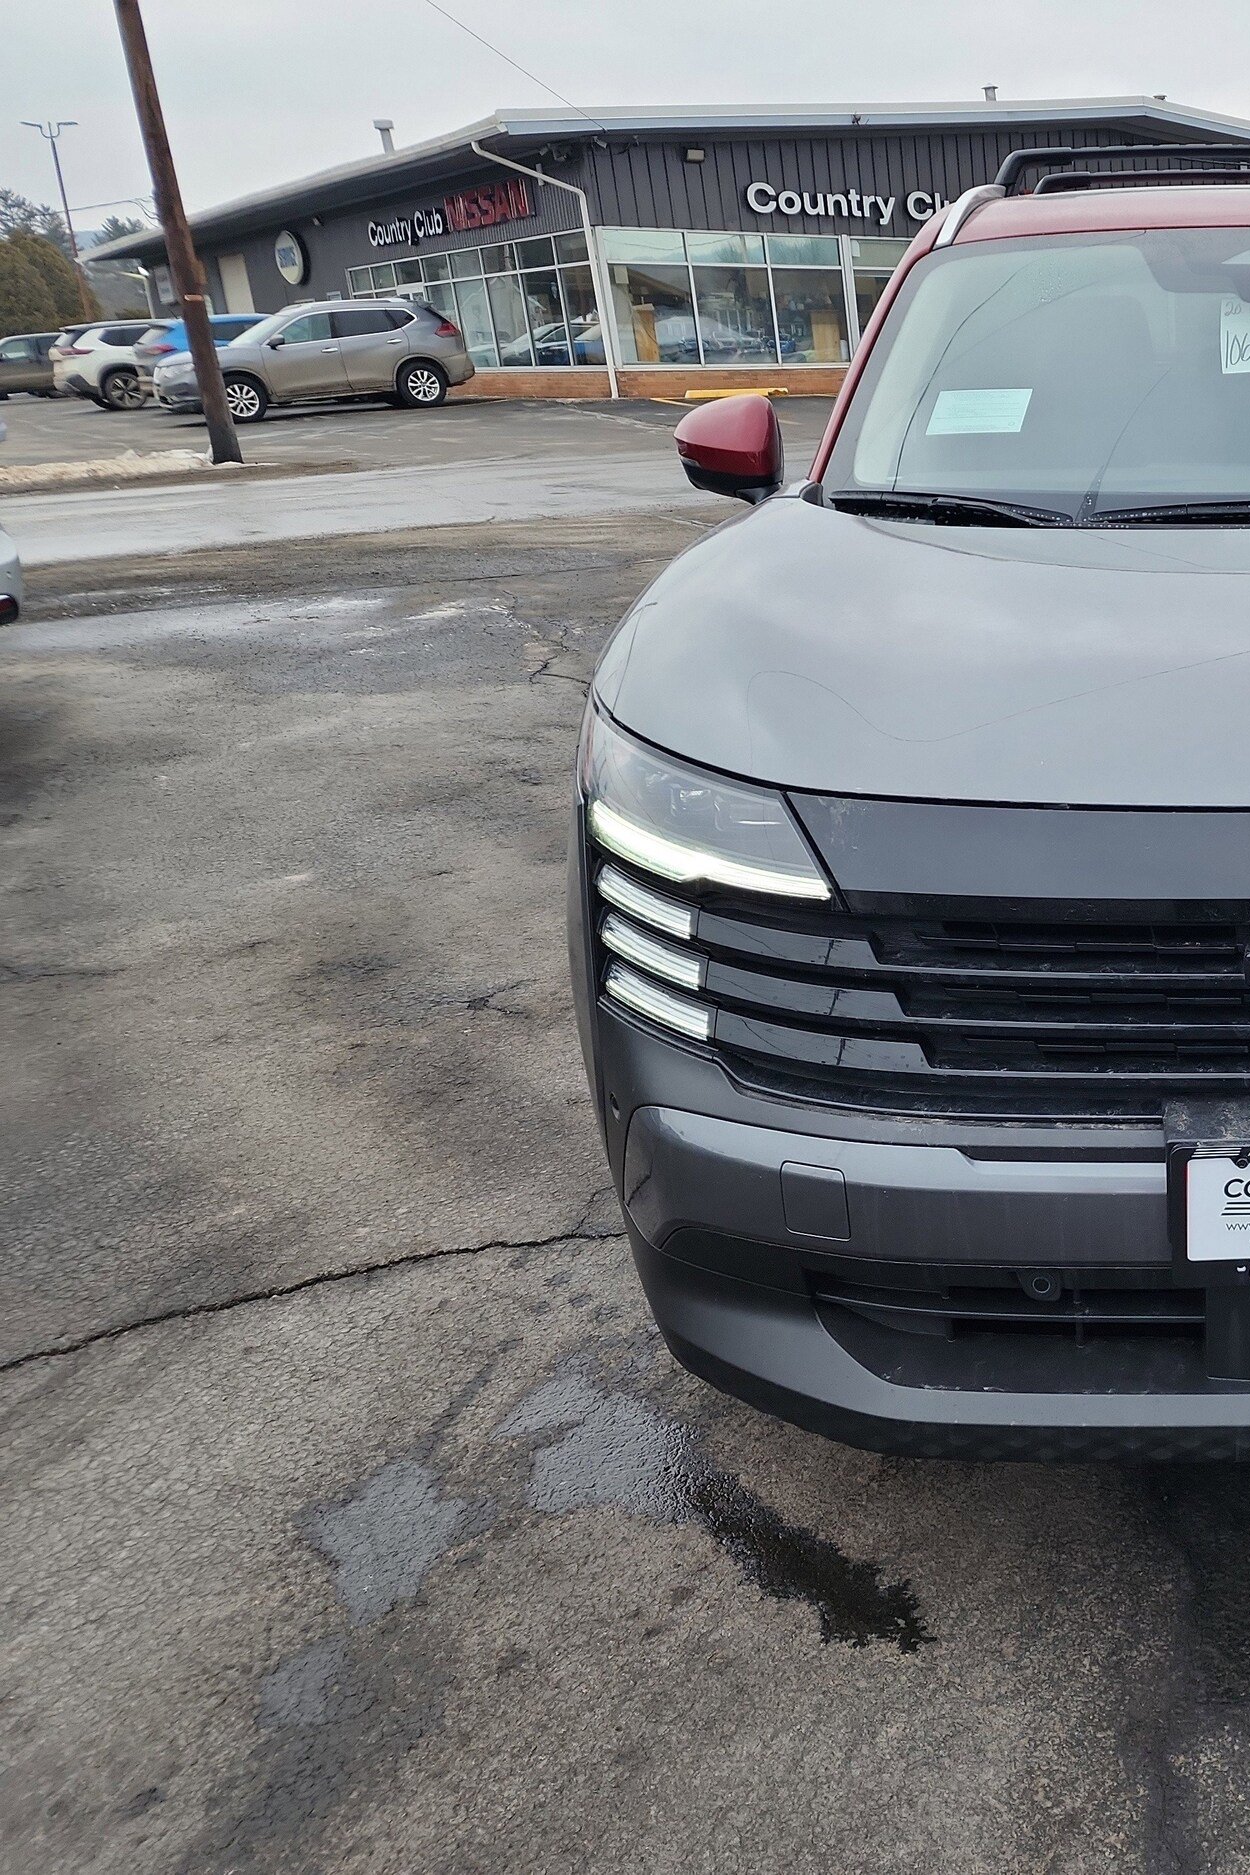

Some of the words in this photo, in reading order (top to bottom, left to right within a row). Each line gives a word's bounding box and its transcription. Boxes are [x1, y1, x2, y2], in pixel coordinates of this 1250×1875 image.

[368, 220, 411, 247] Country
[414, 207, 443, 238] Club
[443, 177, 530, 232] NISSAN
[746, 181, 896, 226] Country
[906, 190, 950, 221] Cl
